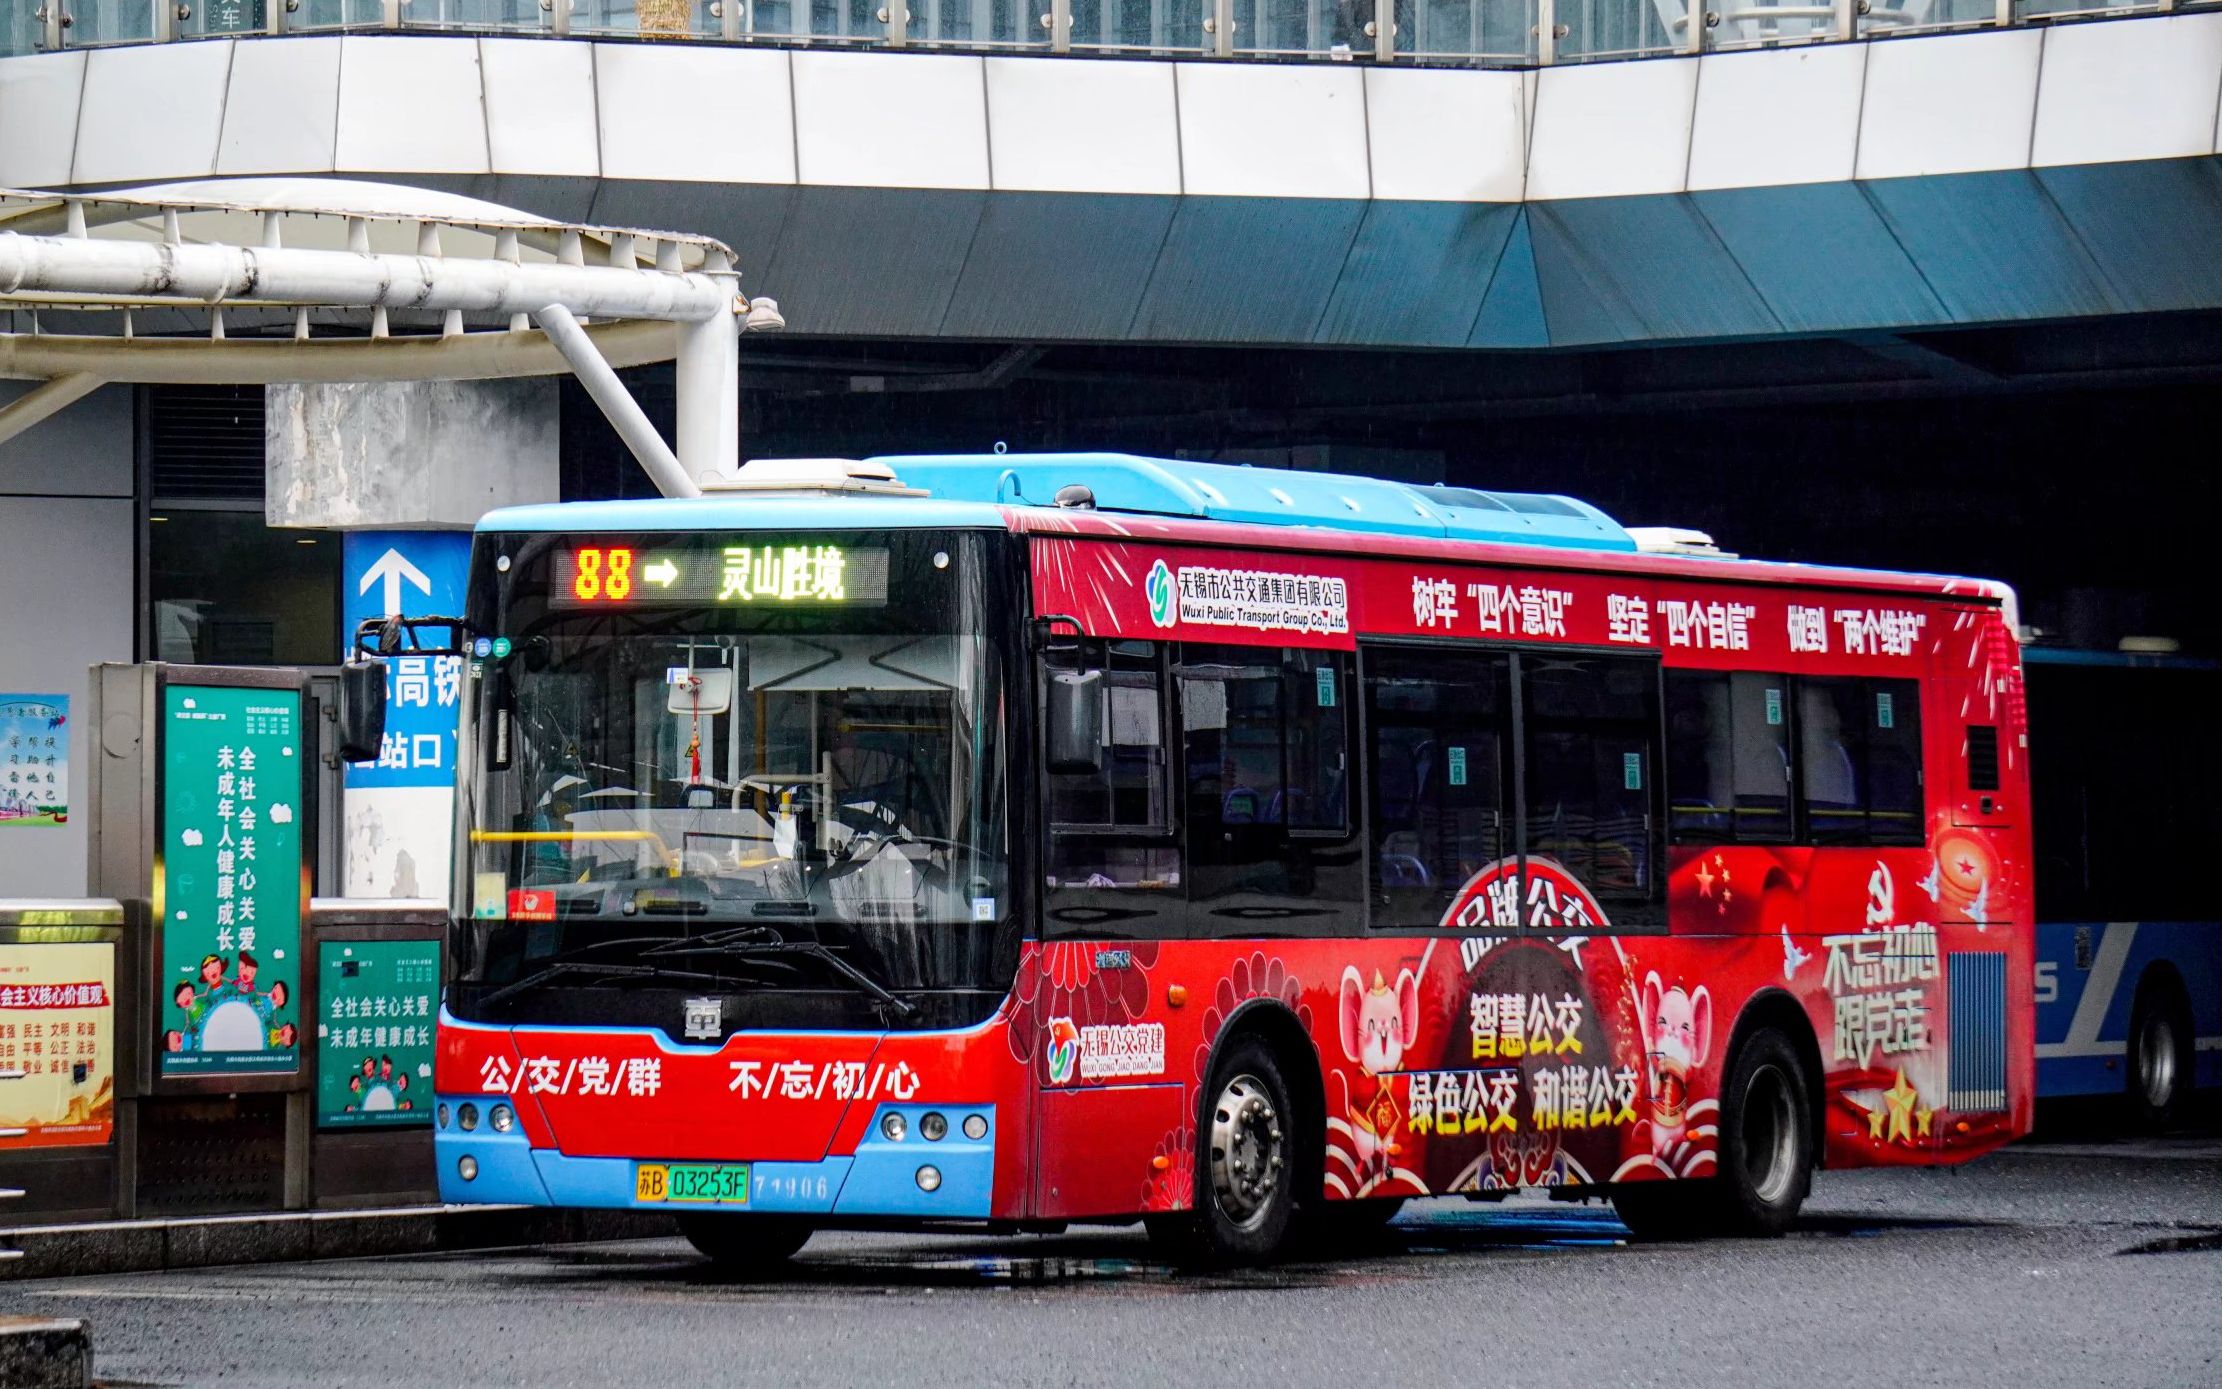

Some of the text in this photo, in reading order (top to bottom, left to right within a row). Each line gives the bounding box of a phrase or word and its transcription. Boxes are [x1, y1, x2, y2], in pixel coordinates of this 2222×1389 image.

[575, 549, 632, 600] 88
[719, 547, 846, 601] 灵山胜境
[1180, 572, 1345, 608] 无锡市公共交通集团有限公司
[1182, 604, 1205, 619] Wuxi
[1207, 606, 1235, 621] Public
[1237, 608, 1280, 626] Transport
[1282, 611, 1309, 628] Group
[1329, 614, 1346, 628] Ltd.
[1412, 576, 1458, 629] 树牢
[1607, 593, 1651, 644] 坚定
[1787, 605, 1828, 653] 做到
[217, 745, 235, 951] 未成年人健康成长
[238, 746, 256, 951] 全社会关心关爱
[1822, 922, 1939, 995] 不忘初心
[0, 985, 103, 1007] 会主义核心价值观
[331, 996, 429, 1018] 全社会关心关爱
[24, 1024, 43, 1038] 民主
[50, 1022, 69, 1037] 文明
[76, 1022, 96, 1036] 和谐
[331, 1025, 429, 1049] 未成年健康成长
[1083, 1027, 1163, 1056] 无锡公交党建
[1470, 992, 1583, 1059] 智慧公交
[23, 1042, 42, 1056] 平等
[50, 1041, 69, 1055] 公正
[77, 1041, 95, 1054] 法治
[23, 1059, 42, 1074] 敬业
[50, 1059, 69, 1073] 诚信
[76, 1058, 95, 1073] 善
[1082, 1062, 1096, 1073] WUXI
[1099, 1062, 1115, 1073] GONG
[1132, 1060, 1148, 1070] DANG
[1150, 1058, 1162, 1070] JIAN
[480, 1057, 921, 1101] 公/交/党/群 不/忘/初/心
[1408, 1065, 1638, 1135] 绿色公交 和谐公交
